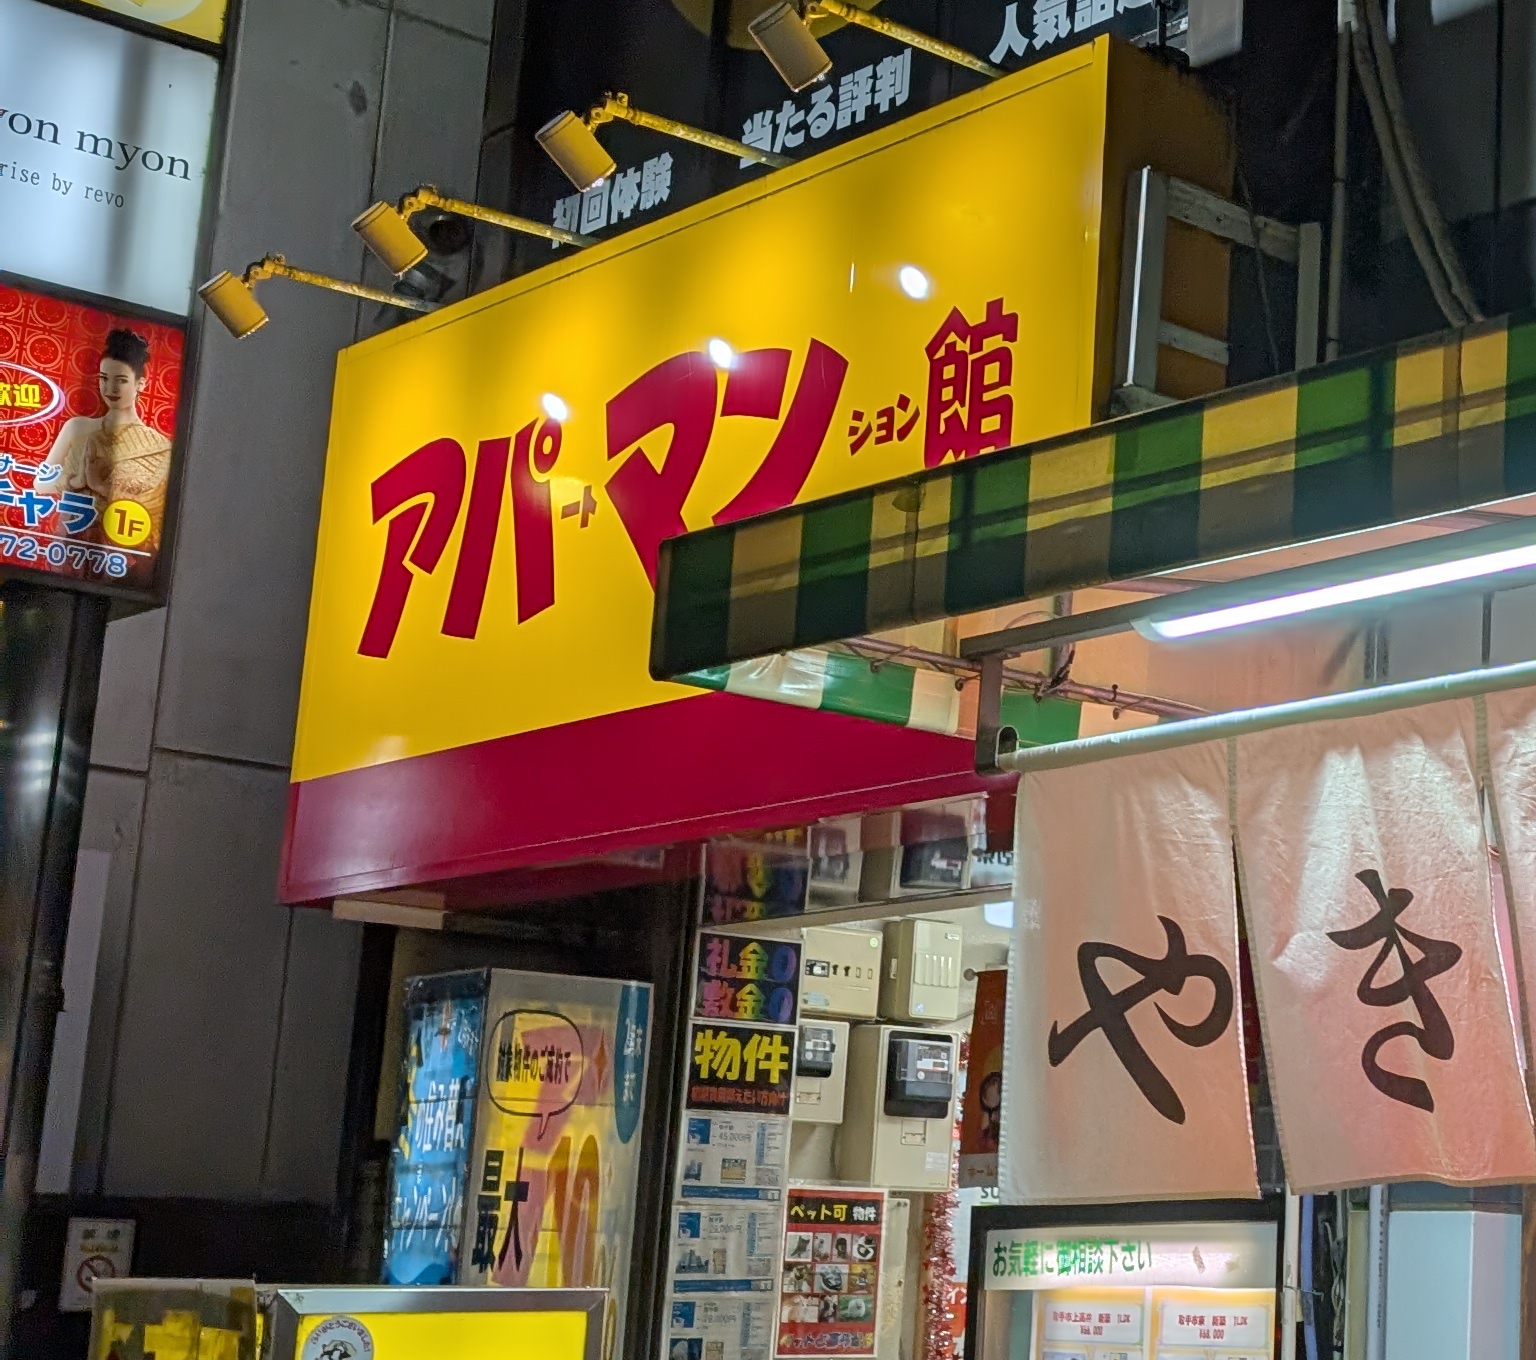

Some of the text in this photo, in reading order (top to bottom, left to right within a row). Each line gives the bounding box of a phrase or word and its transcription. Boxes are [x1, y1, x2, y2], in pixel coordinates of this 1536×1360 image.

[0, 107, 191, 181] on myon
[52, 173, 73, 196] by
[85, 184, 124, 209] revo
[114, 509, 144, 537] 1F
[694, 1029, 790, 1083] 物件
[791, 1204, 848, 1221] ペット可
